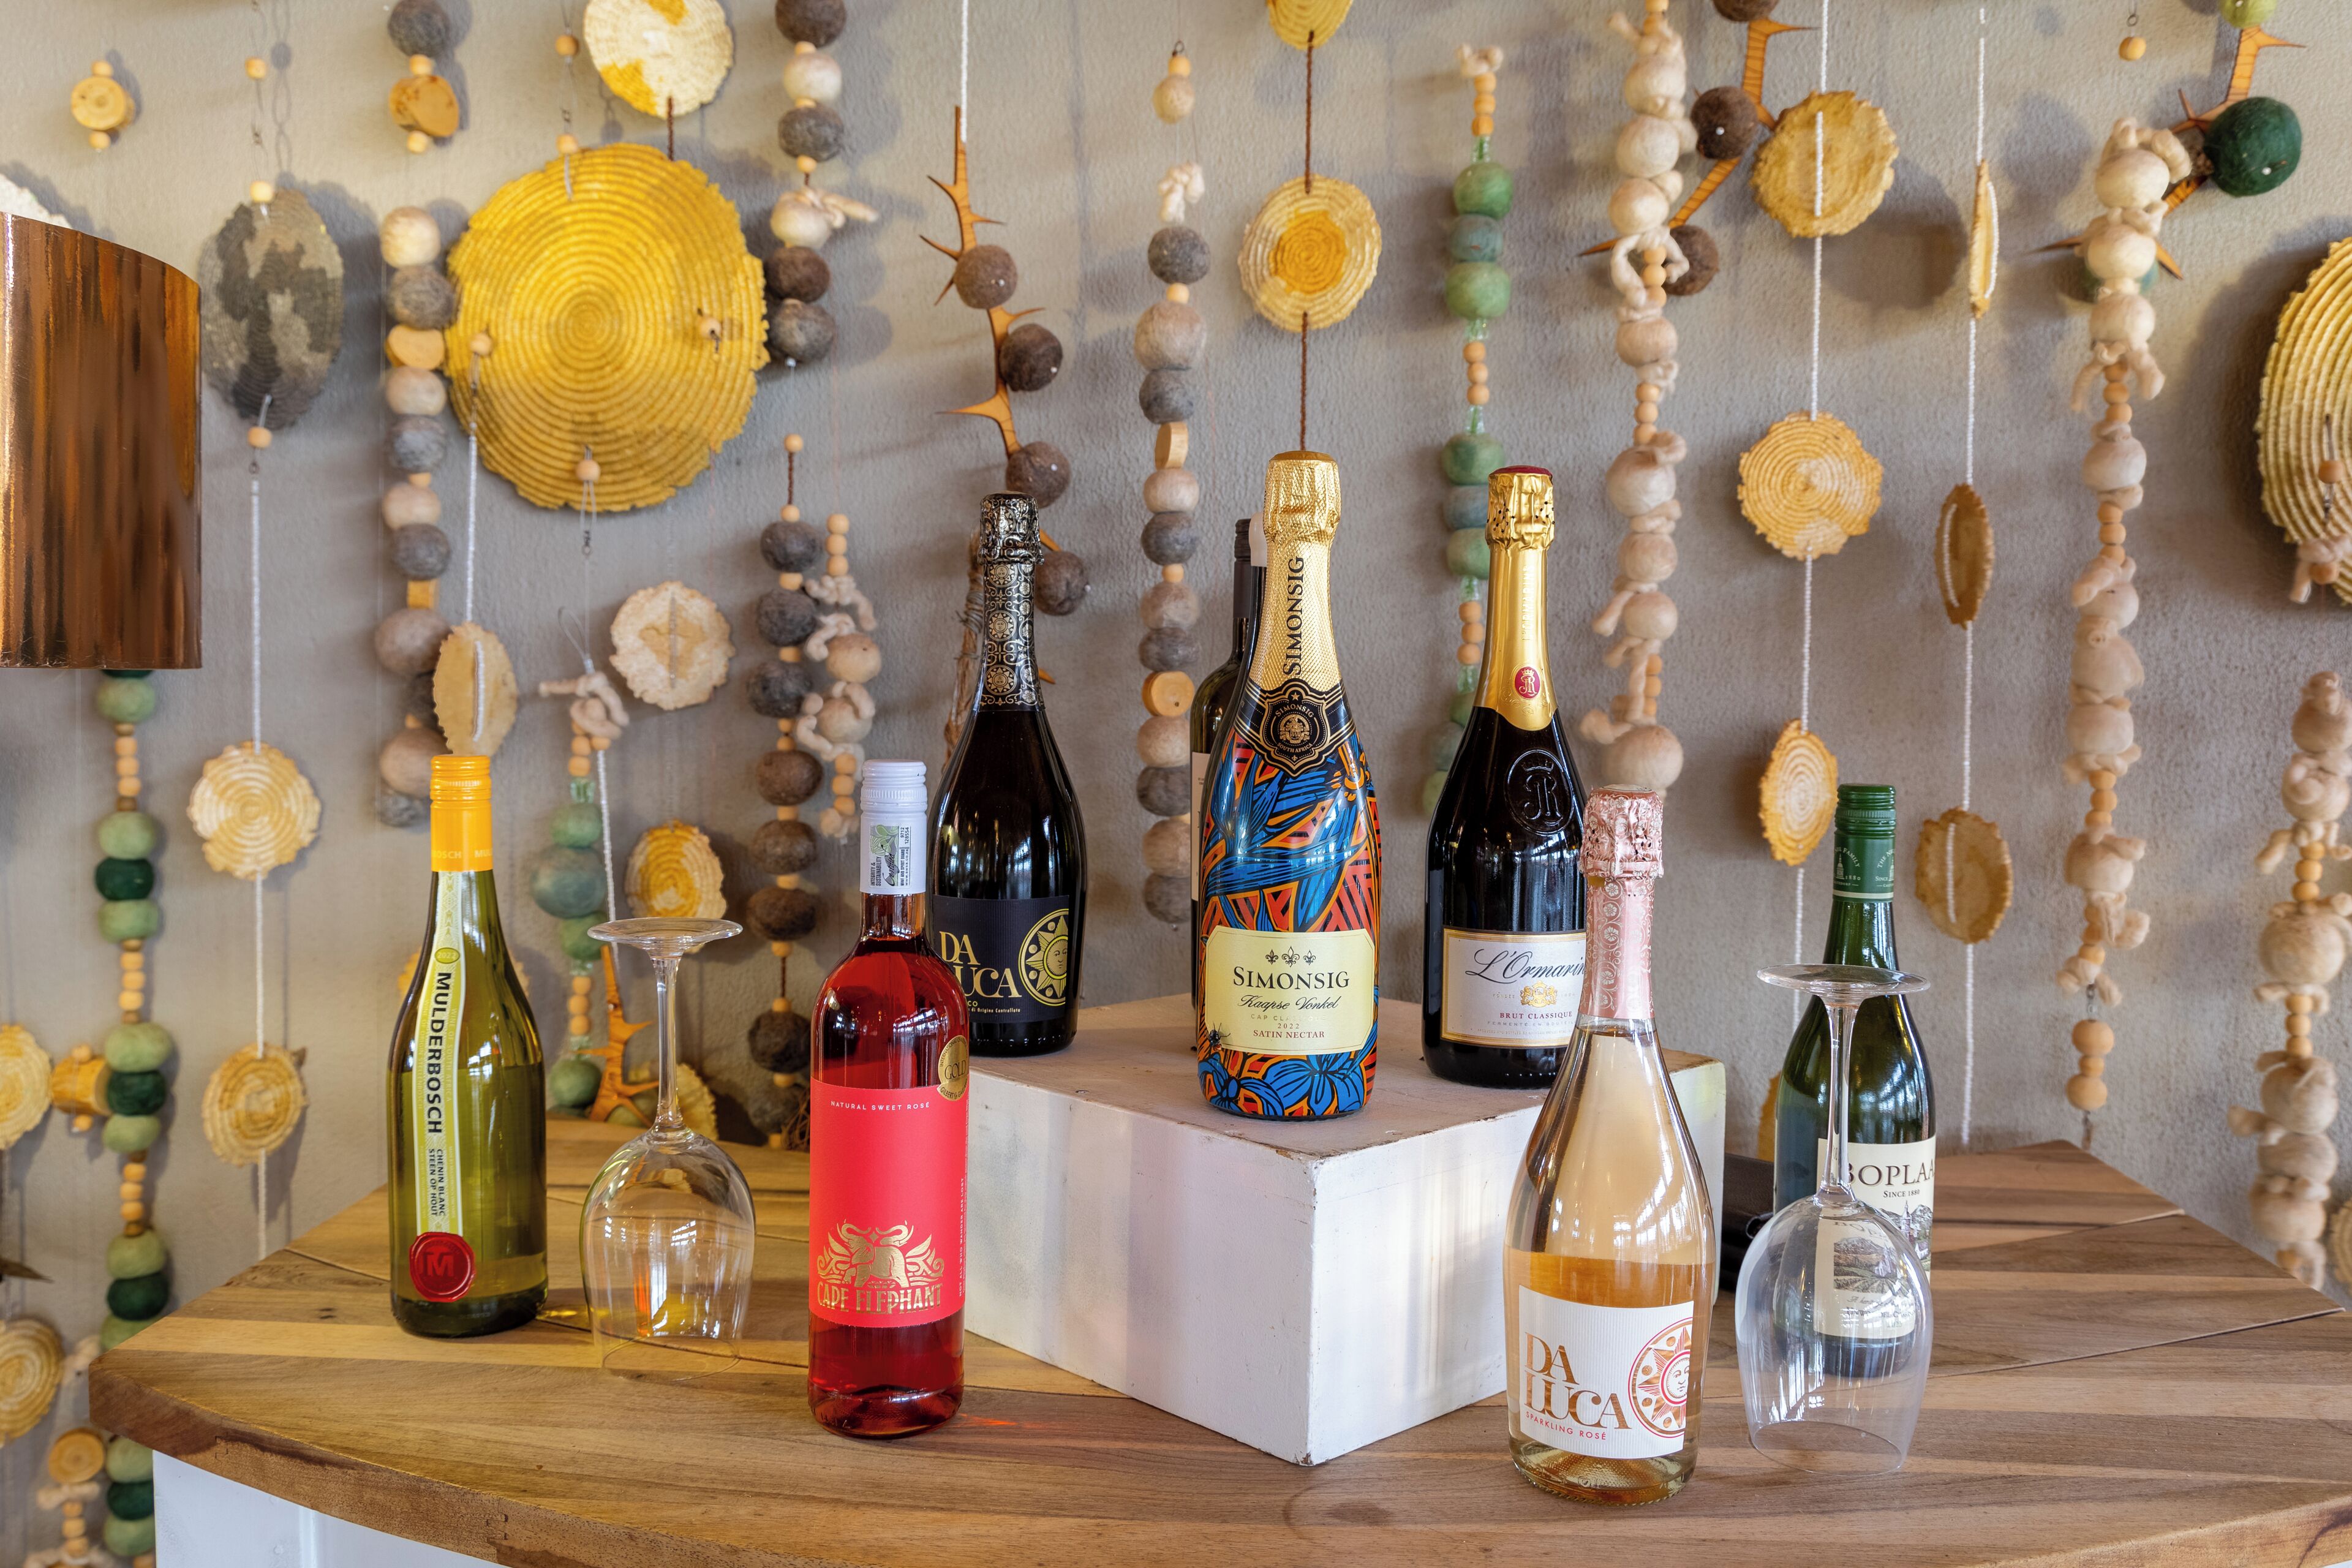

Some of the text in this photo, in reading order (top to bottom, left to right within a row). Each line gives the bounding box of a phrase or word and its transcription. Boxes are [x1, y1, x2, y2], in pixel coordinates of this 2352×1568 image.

[1283, 556, 1304, 676] SIMONSIG
[1276, 704, 1314, 717] SIMONSIG
[1277, 742, 1313, 753] SOUTH AFRICA
[881, 845, 900, 886] Certified
[1843, 848, 1860, 867] FAMILY
[1877, 856, 1887, 868] THE
[940, 931, 981, 965] DA
[953, 965, 1022, 998] UCA
[1233, 966, 1350, 990] SIMONSIG
[1238, 994, 1342, 1012] Kaapse Vonkel
[1528, 1011, 1572, 1020] CLASSIQUE
[1253, 1030, 1282, 1038] SATIN
[427, 973, 452, 1133] MULDERBOSCH
[944, 1060, 967, 1080] GOLD
[941, 1087, 954, 1099] GILBERT
[831, 1101, 866, 1110] NATURAL
[907, 1101, 930, 1110] ROSÉ
[430, 1178, 437, 1190] OP
[817, 1281, 943, 1314] CAPE ELEPHANT
[1525, 1332, 1580, 1385] DA
[1524, 1370, 1632, 1430] LUCA
[1526, 1411, 1607, 1440] SPARKLING ROSÉ
